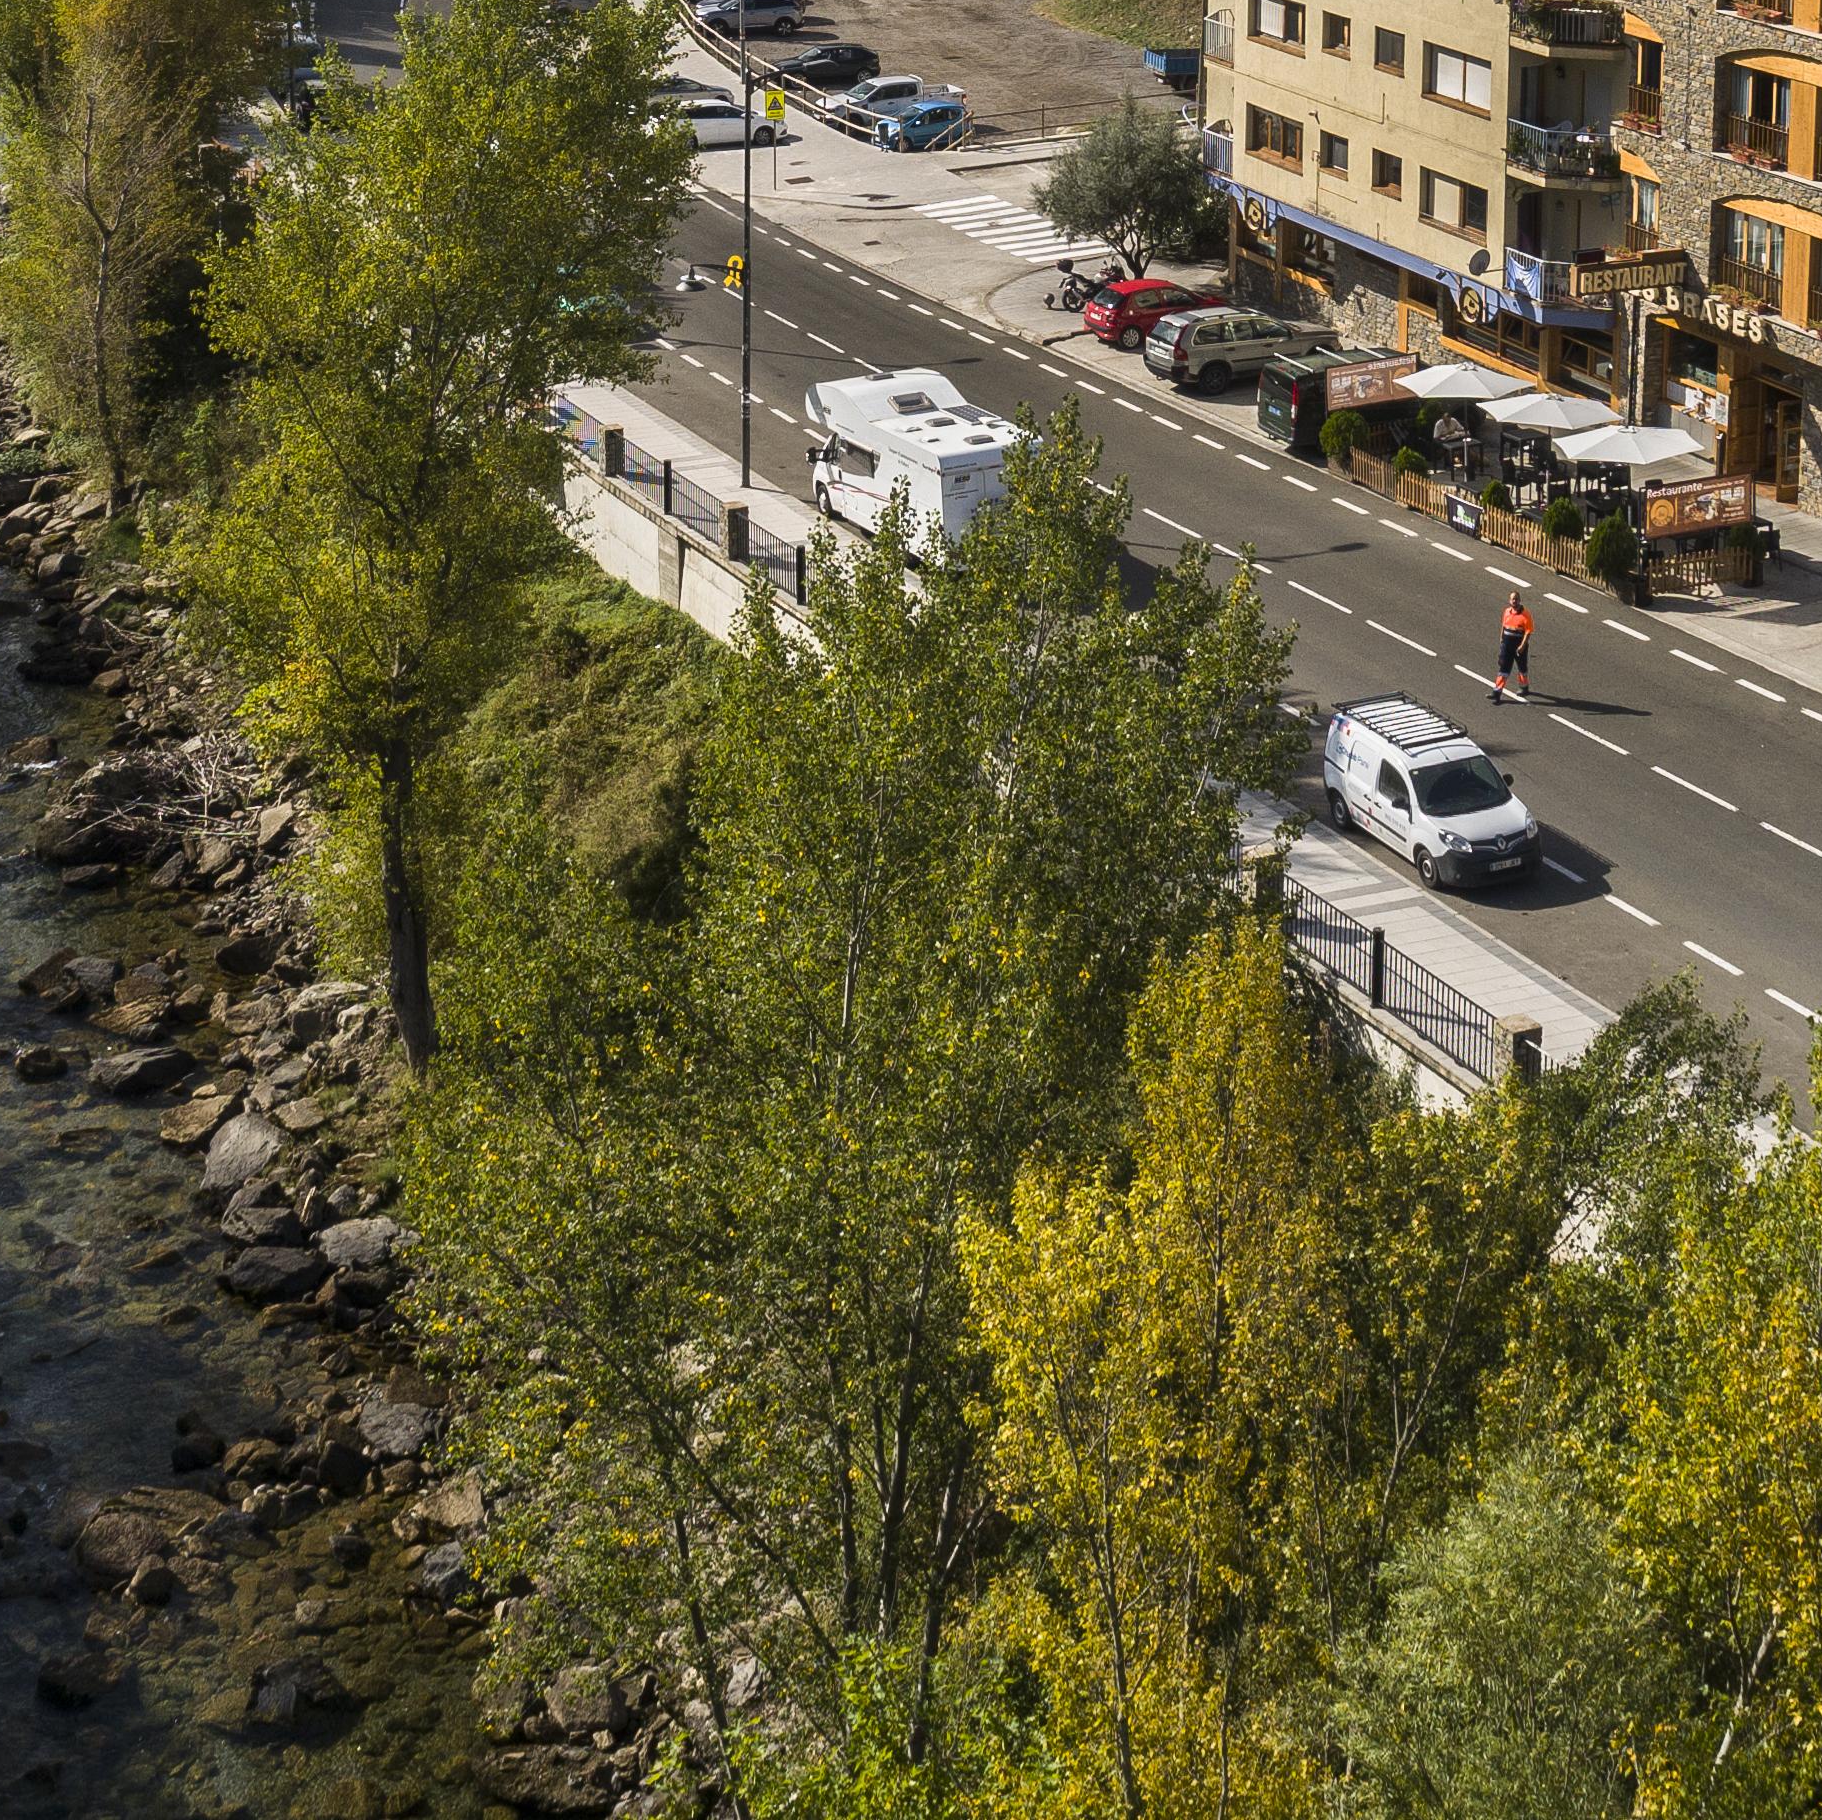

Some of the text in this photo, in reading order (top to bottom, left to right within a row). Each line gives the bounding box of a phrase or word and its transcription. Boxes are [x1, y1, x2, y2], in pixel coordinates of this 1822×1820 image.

[1581, 262, 1687, 294] RESTAURANT
[1666, 286, 1764, 344] BRASES
[1646, 482, 1702, 499] Restaurante
